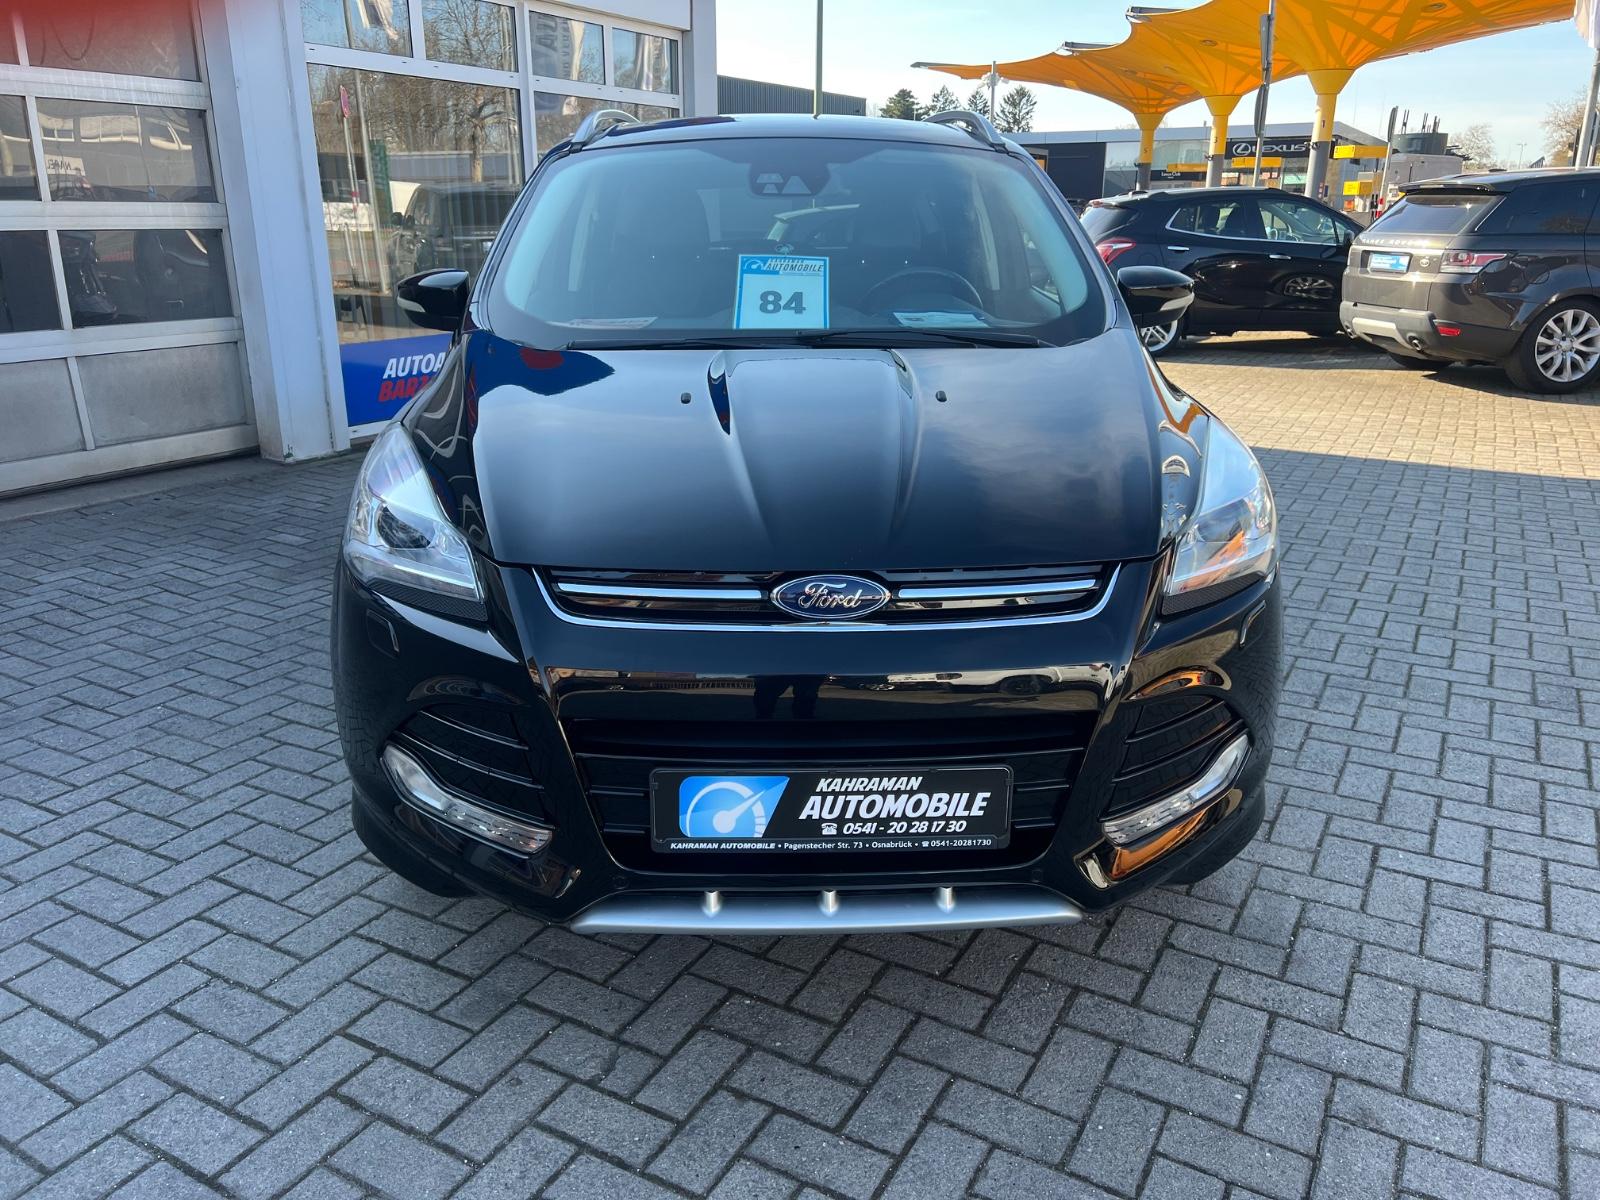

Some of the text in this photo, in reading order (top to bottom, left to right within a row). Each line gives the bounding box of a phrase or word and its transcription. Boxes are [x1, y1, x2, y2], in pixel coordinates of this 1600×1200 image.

[766, 262, 824, 272] AUTOMOBILE
[759, 290, 806, 314] 84
[798, 582, 863, 608] Ford
[815, 776, 923, 792] KAHRAMAN
[798, 792, 991, 820] AUTOMOBILE
[842, 822, 877, 835] 0541
[887, 821, 907, 834] 20
[909, 821, 928, 833] 28
[931, 821, 946, 833] 17
[946, 820, 967, 833] 30
[670, 839, 992, 851] KAHRAMAN AUTOMOBILE Pagenstecher Str. 73 Osnabrück 0541-20281730
